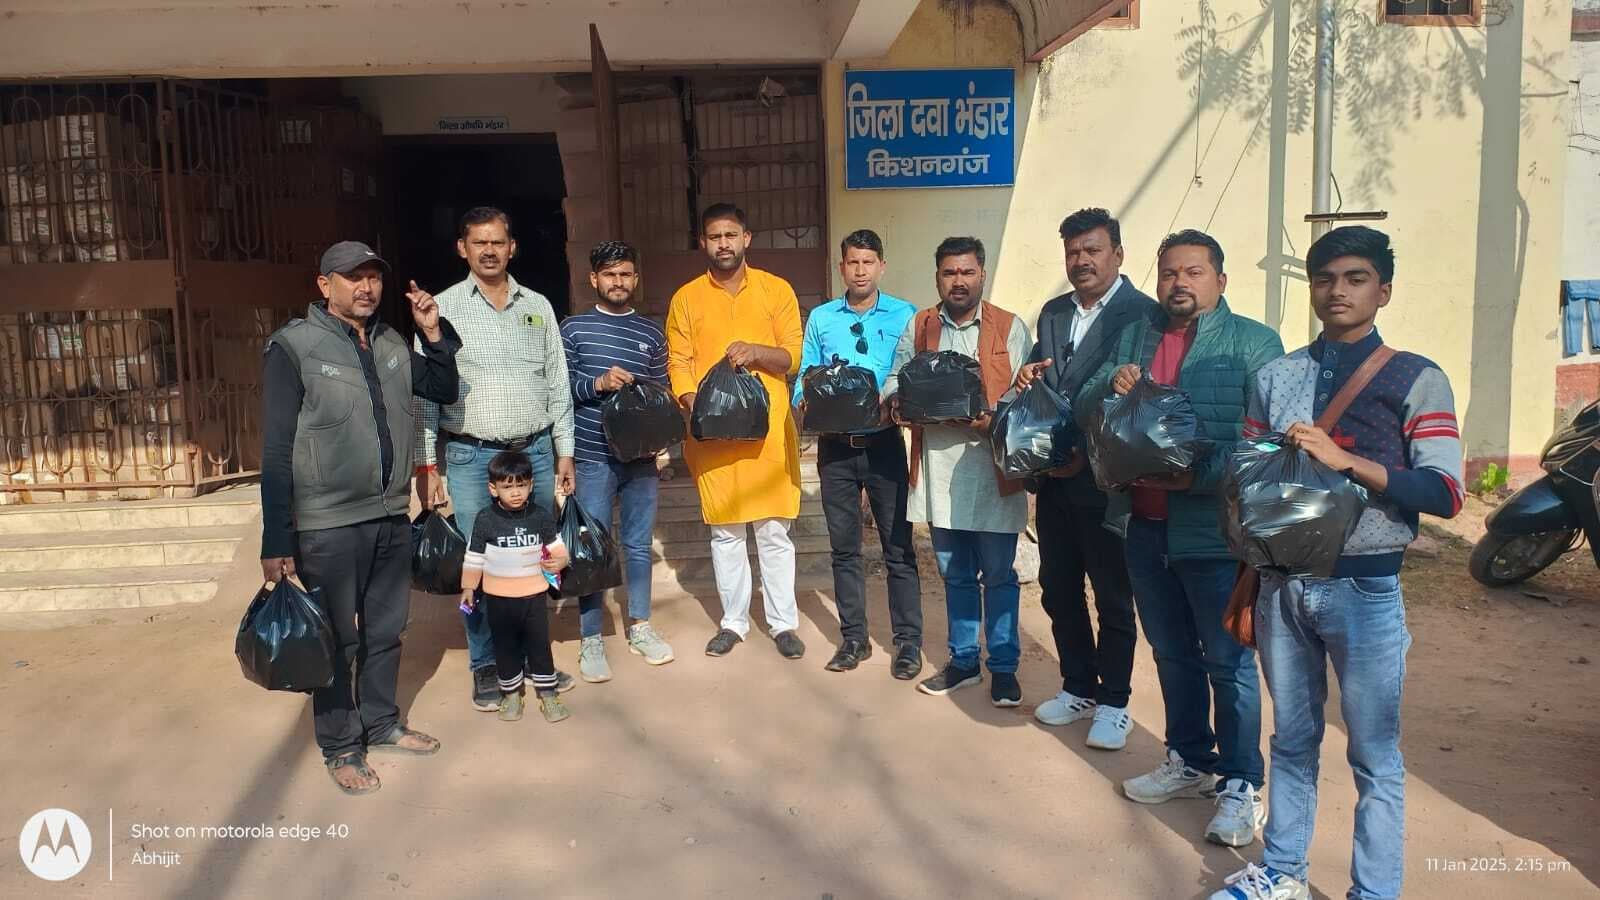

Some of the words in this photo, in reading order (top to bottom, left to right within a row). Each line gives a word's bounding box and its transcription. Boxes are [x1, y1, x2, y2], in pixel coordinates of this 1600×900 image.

[848, 82, 905, 141] जिला
[910, 98, 950, 137] दवा
[955, 81, 1011, 140] भंडार
[866, 147, 991, 178] किशनगंज
[497, 533, 540, 547] FENDI
